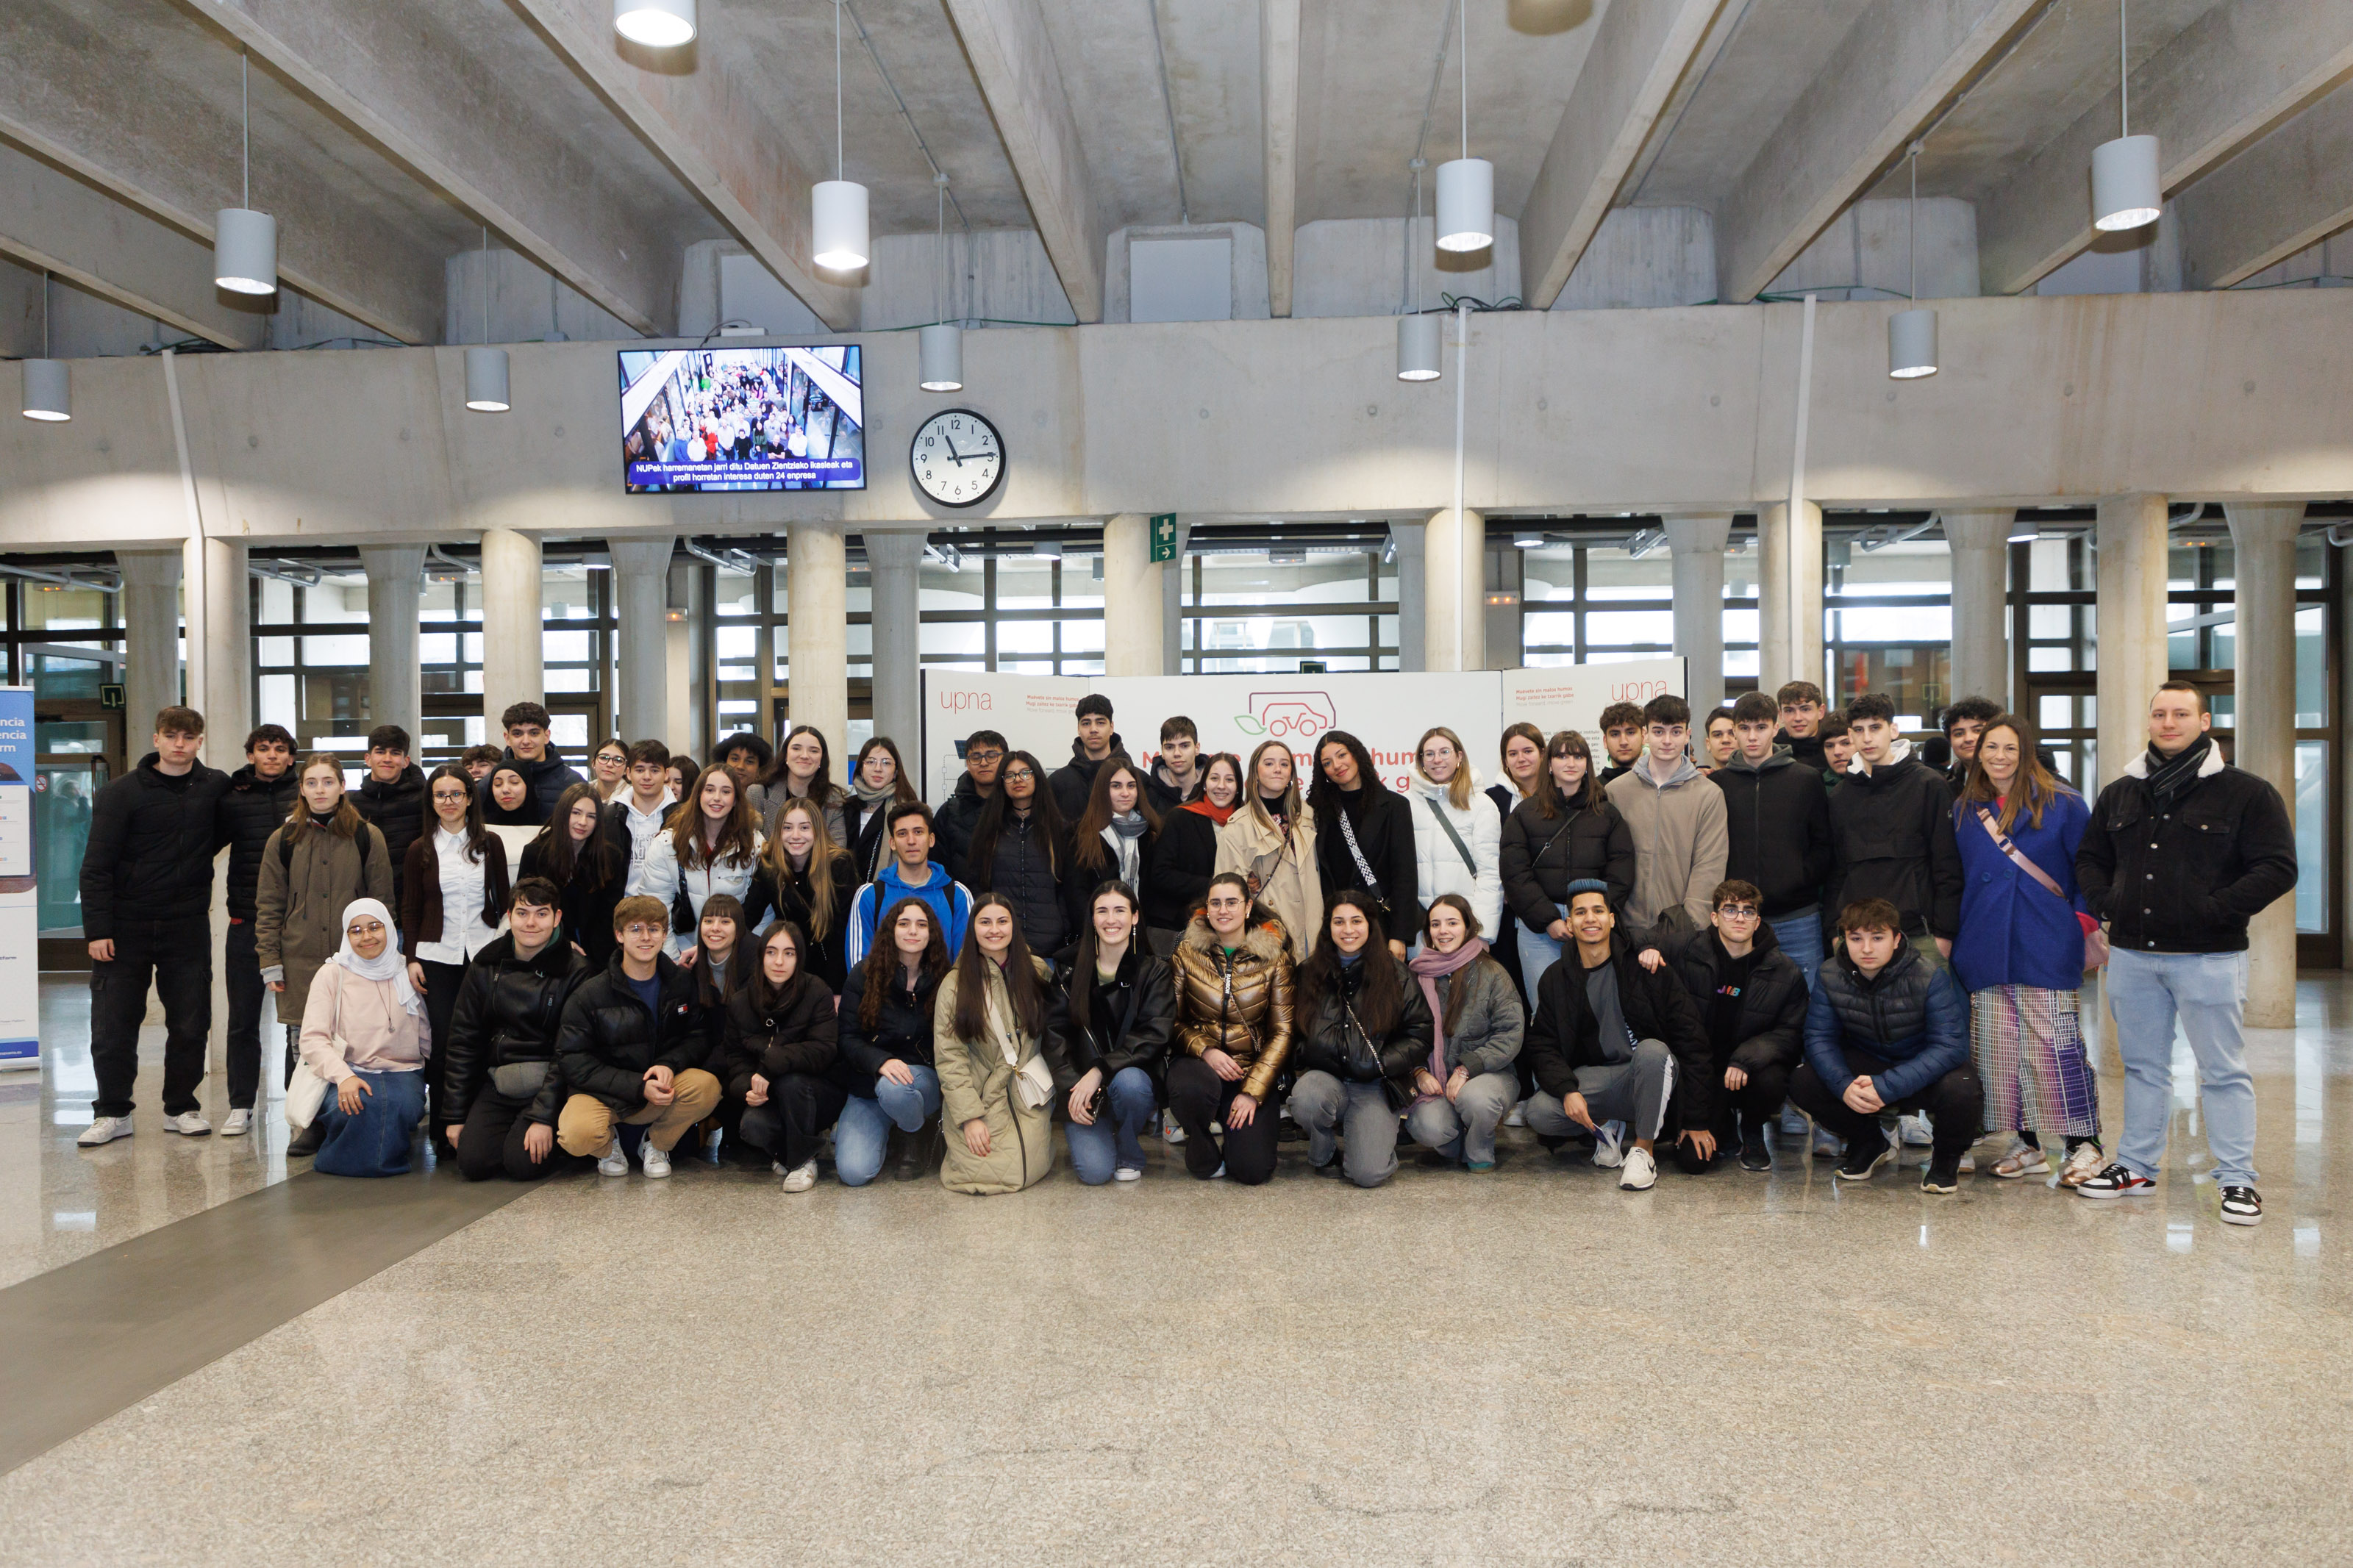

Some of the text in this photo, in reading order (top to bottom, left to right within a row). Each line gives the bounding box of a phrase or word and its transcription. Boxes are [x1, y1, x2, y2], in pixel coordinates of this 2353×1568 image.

[951, 420, 960, 429] 12
[971, 424, 974, 434] 1
[938, 426, 944, 435] 11
[925, 437, 935, 447] 10
[982, 435, 988, 445] 2
[920, 454, 927, 463] 9
[636, 464, 662, 473] NUPek
[663, 463, 713, 472] harremanetan
[713, 463, 727, 473] jarri
[729, 462, 743, 471] ditu
[744, 462, 770, 470] Datuen
[772, 462, 809, 470] Zientziako
[673, 471, 816, 482] profil horretan interesa duten 24 enpresa
[926, 470, 932, 479] 8
[982, 468, 989, 478] 4
[941, 482, 947, 490] 7
[954, 486, 961, 495] 6
[971, 481, 978, 490] 5
[1612, 680, 1667, 702] upna
[940, 691, 993, 715] upna
[0, 717, 25, 727] ncia
[1371, 748, 1415, 765] hum
